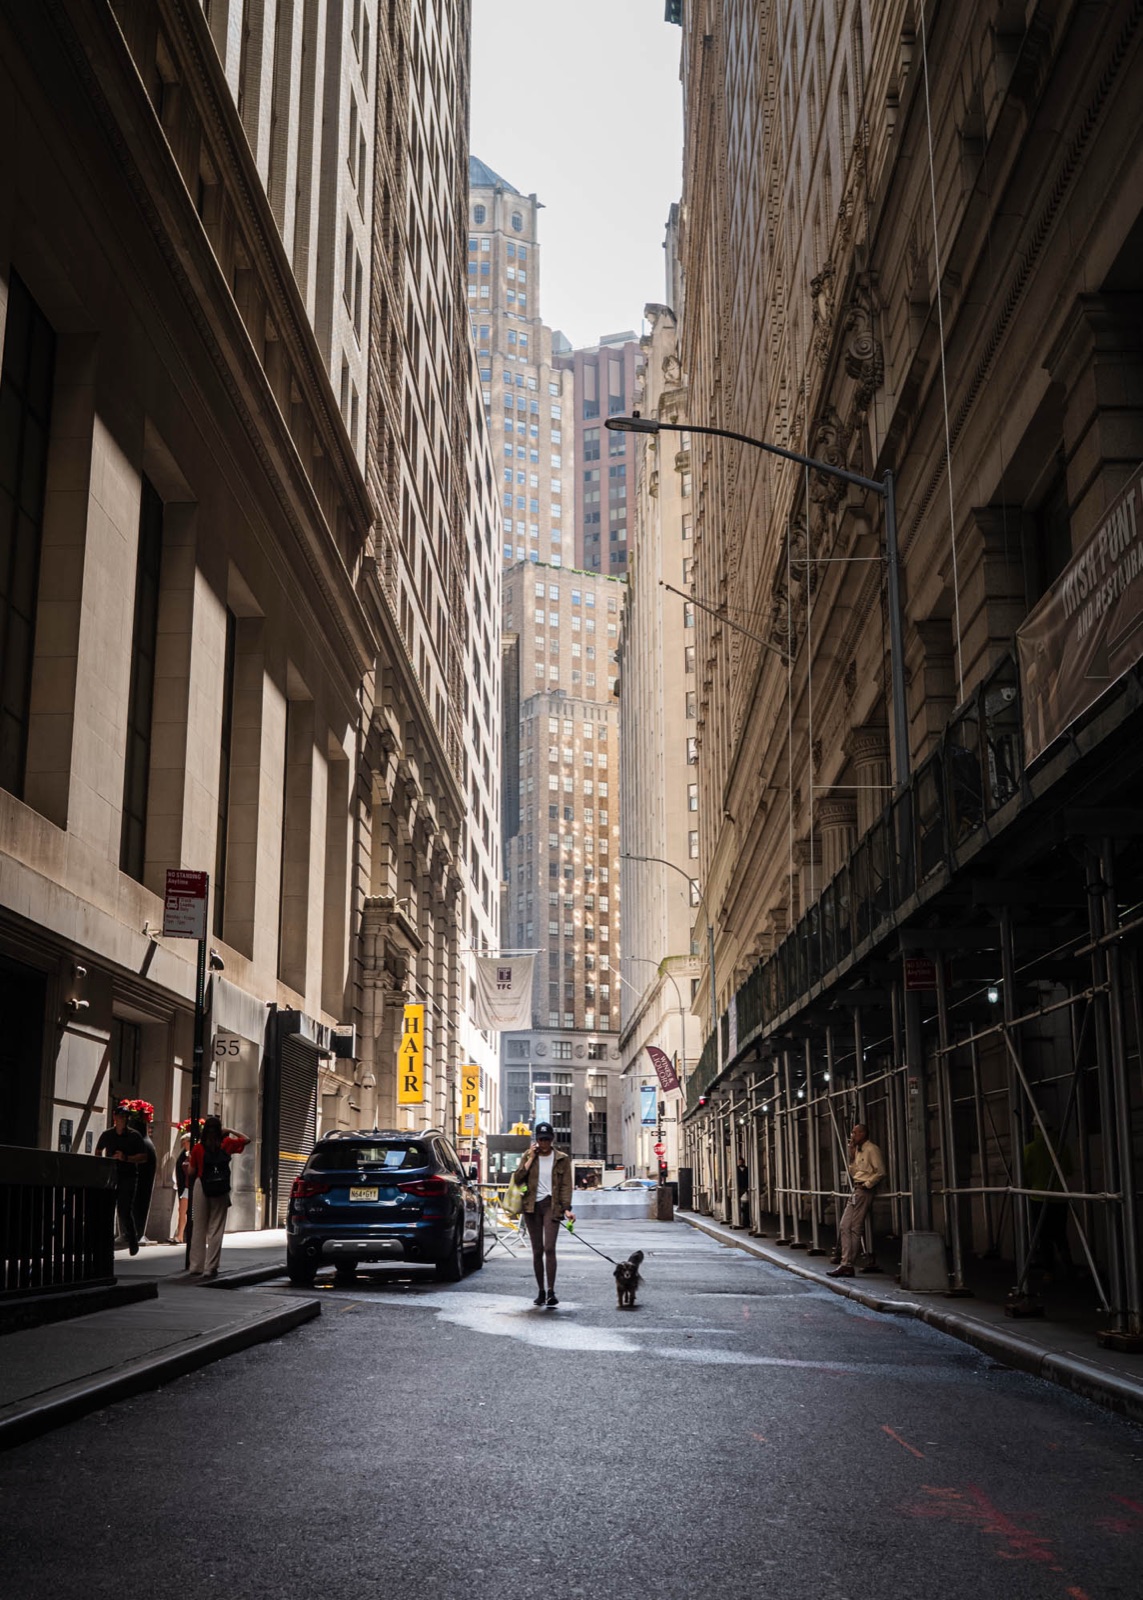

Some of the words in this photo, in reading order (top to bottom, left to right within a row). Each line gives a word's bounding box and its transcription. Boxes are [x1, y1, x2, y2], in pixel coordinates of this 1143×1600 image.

[1062, 543, 1098, 620] IRISH
[1099, 488, 1137, 576] PUNT
[1077, 601, 1094, 642] AND
[176, 872, 202, 880] STANDING
[215, 1040, 240, 1057] 55
[404, 1017, 419, 1092] HAIR
[660, 1055, 673, 1077] WINES
[651, 1053, 670, 1088] LIQUORS
